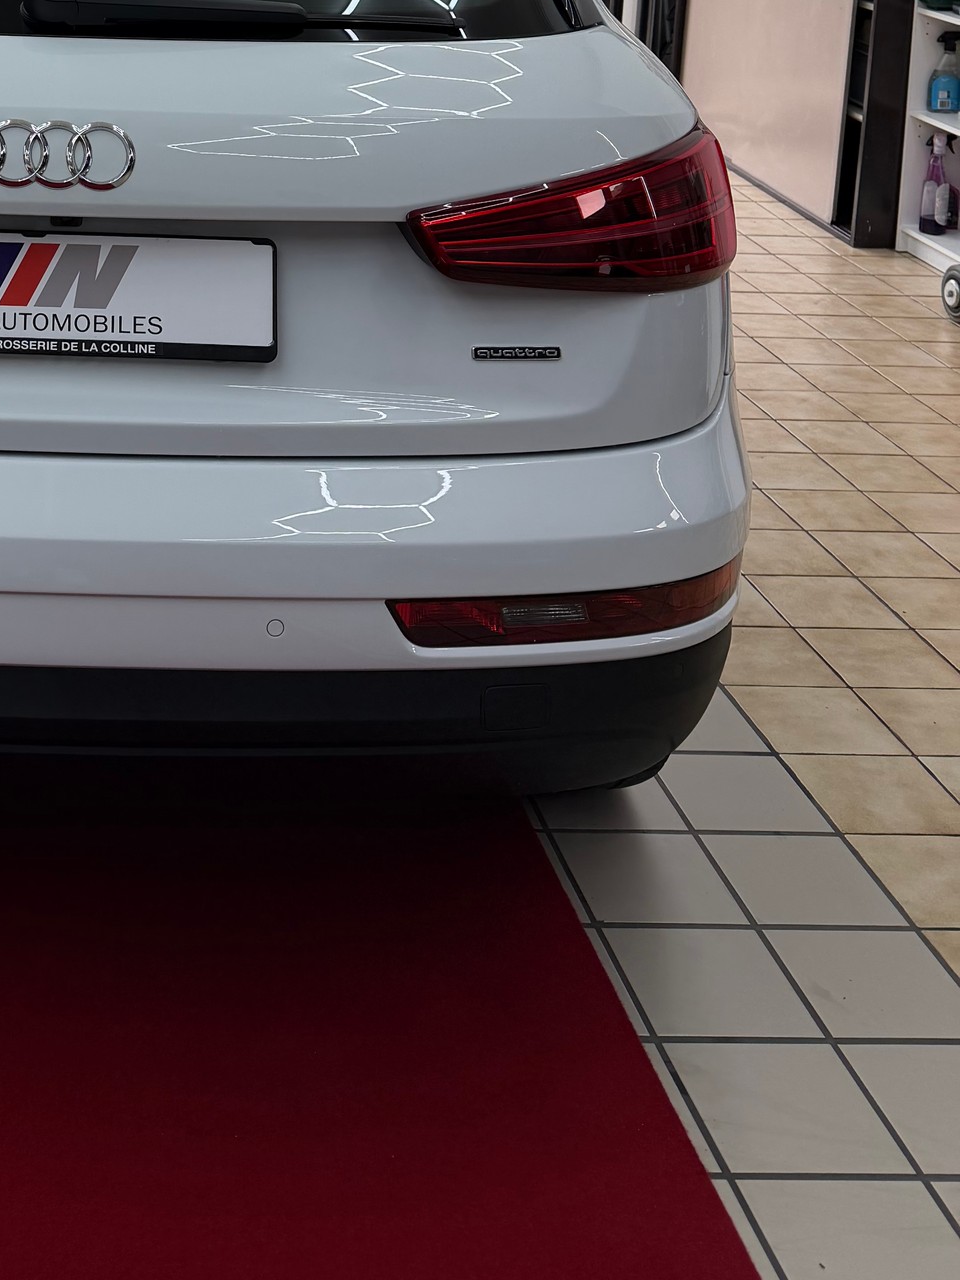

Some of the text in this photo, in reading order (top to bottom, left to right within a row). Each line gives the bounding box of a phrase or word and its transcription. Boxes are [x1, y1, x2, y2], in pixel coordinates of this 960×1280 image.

[61, 341, 79, 351] DE
[82, 342, 99, 352] LA
[101, 342, 156, 354] COLLINE
[477, 348, 558, 358] quattro
